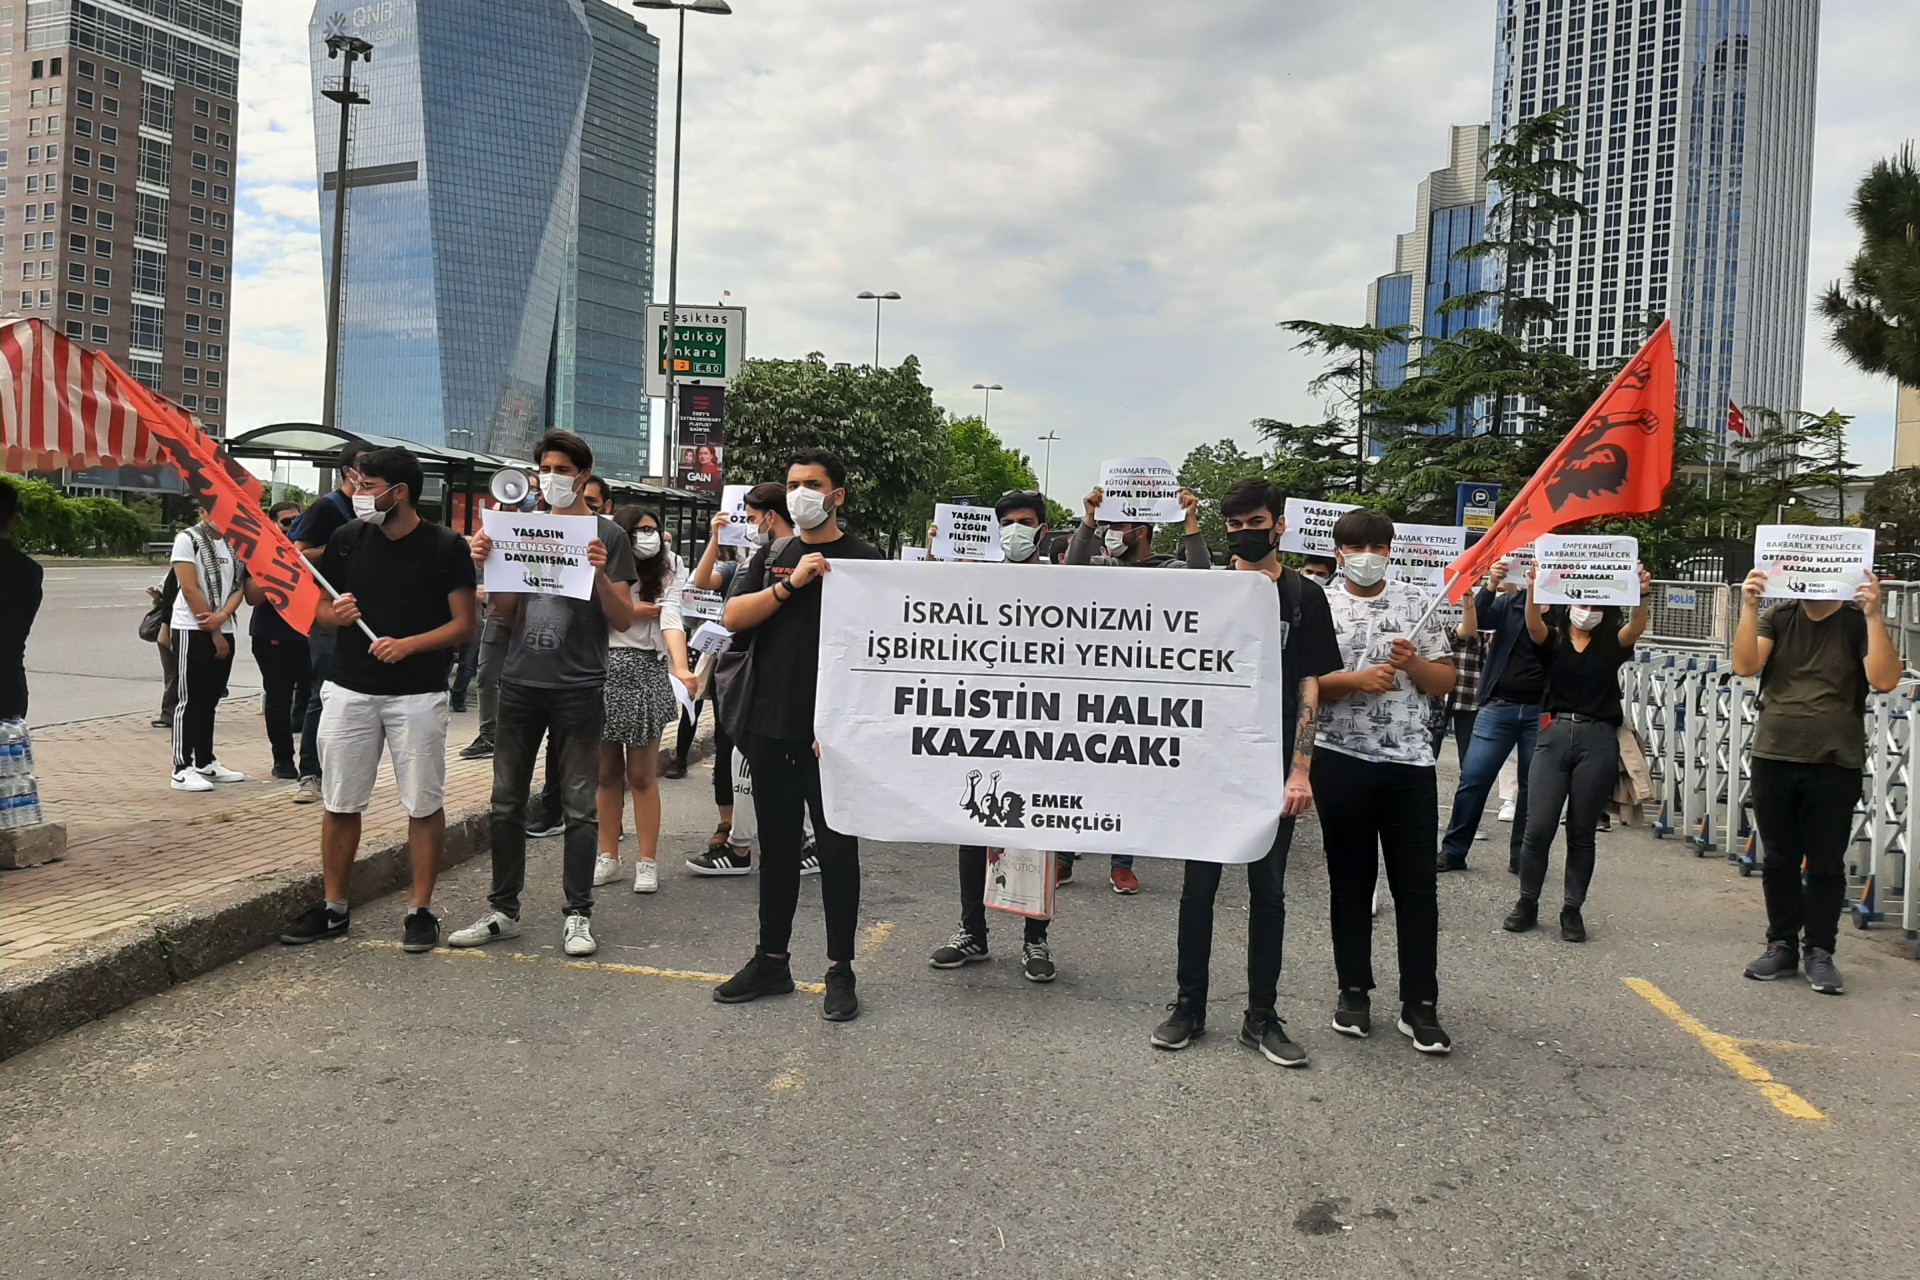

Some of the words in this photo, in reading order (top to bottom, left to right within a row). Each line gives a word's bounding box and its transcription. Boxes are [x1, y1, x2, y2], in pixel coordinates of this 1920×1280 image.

[353, 1, 393, 27] QNB
[663, 330, 723, 345] Kadıköy
[1109, 467, 1146, 475] KINAMAK
[1106, 487, 1133, 498] İPTAL
[1136, 488, 1178, 499] EDİLSİN!
[1475, 492, 1486, 501] P
[952, 511, 991, 522] YAŞASIN
[1305, 515, 1334, 527] ÖZGÜ
[954, 520, 987, 532] ÖZGÜR
[1299, 526, 1332, 538] FİLİSTİ
[512, 528, 564, 540] YAŞASIN
[949, 531, 991, 543] FİLİSTİN!
[1393, 534, 1422, 543] NAMAK
[1425, 536, 1457, 545] YETMEZ
[1787, 532, 1843, 541] EMPERYALİST
[492, 541, 588, 556] ENTERNASYONAL
[1407, 547, 1459, 557] ANLAŞMALAR
[1563, 542, 1613, 550] EMPERYALİST
[1766, 541, 1812, 550] BARBARLIK
[1815, 542, 1863, 551] YENİLECEK
[504, 553, 579, 567] DAYANIŞMA!
[1589, 551, 1631, 559] YENİLECEK
[1762, 553, 1813, 562] ORTADOĞU
[1390, 557, 1408, 566] TAL
[1411, 557, 1450, 568] EDİLSİN
[1541, 562, 1588, 570] ORTADOĞU
[1590, 563, 1632, 571] HALKLARI
[1783, 564, 1843, 573] KAZANACAK!
[1668, 593, 1695, 605] POLİS
[903, 595, 989, 626] İSRAİL
[998, 598, 1152, 632] SİYONİZMİ
[1163, 610, 1199, 633] VE
[868, 630, 1065, 669] İŞBİRLİKÇİLERİ
[1075, 639, 1236, 673] YENİLECEK
[894, 678, 1061, 721] FİLİSTİN
[1077, 693, 1203, 728] HALKI
[911, 726, 1180, 768] KAZANACAK!
[1031, 793, 1083, 810] EMEK
[1030, 812, 1122, 834] GENÇLİĞİ
